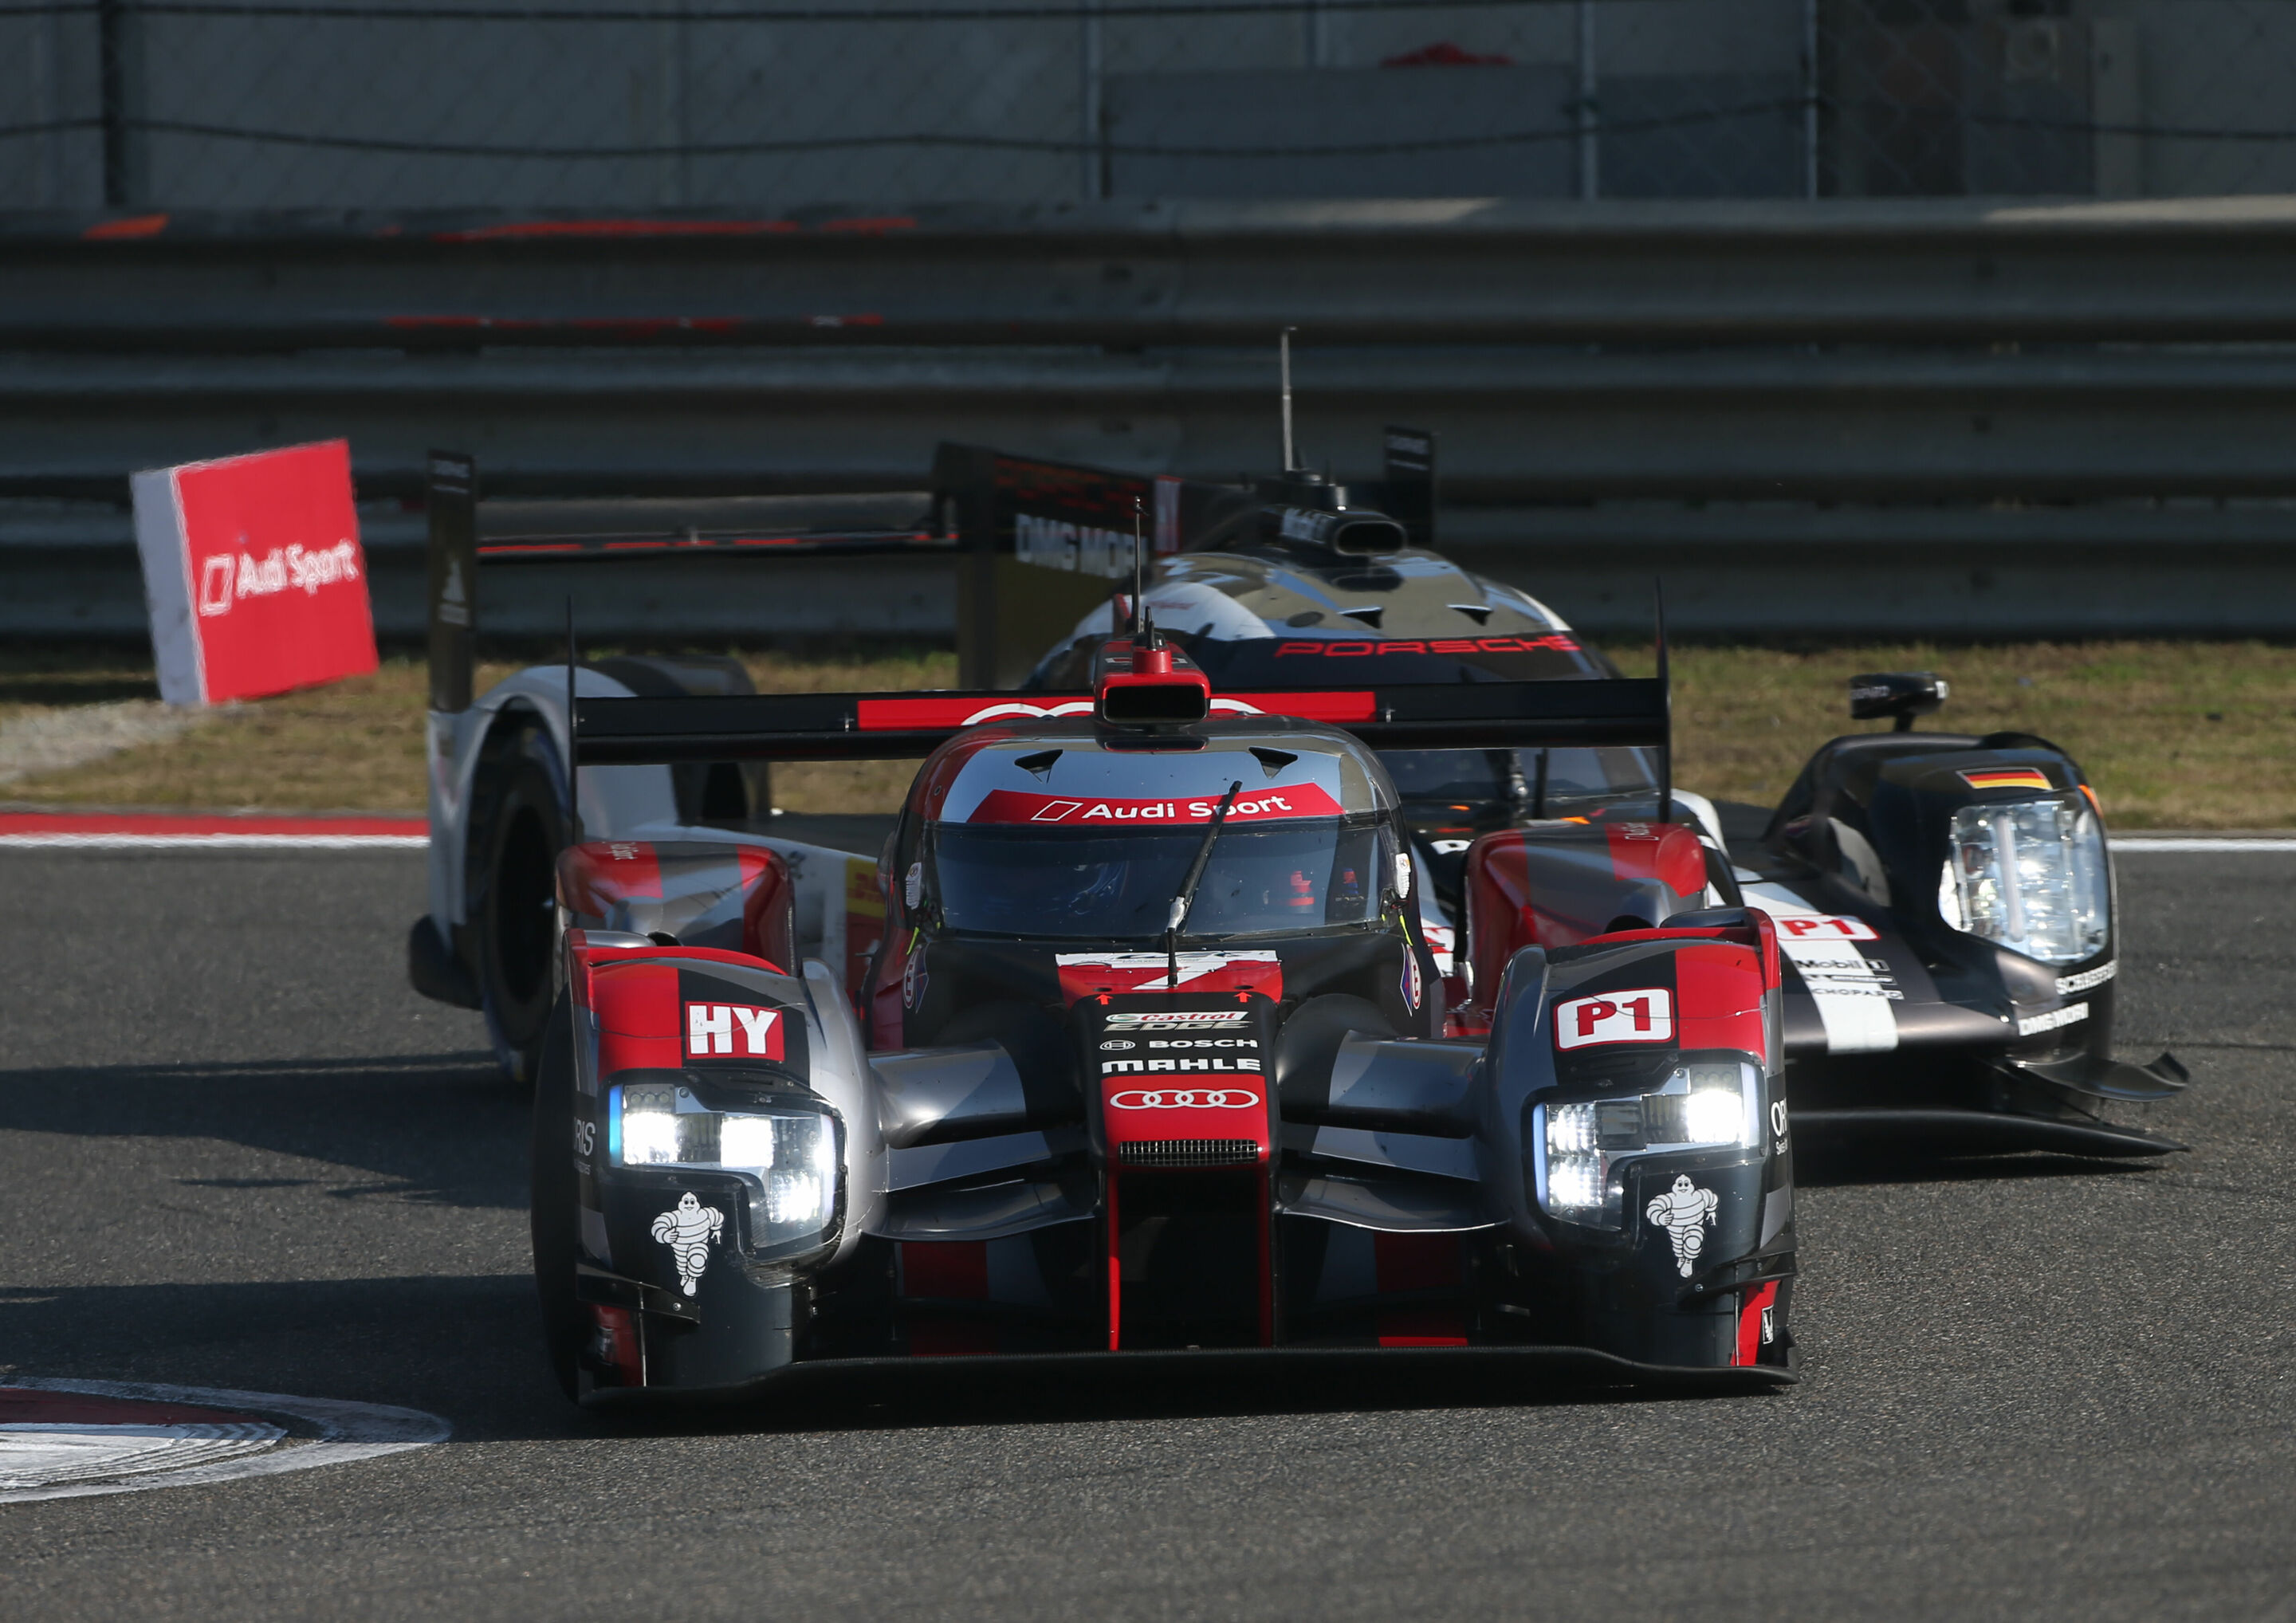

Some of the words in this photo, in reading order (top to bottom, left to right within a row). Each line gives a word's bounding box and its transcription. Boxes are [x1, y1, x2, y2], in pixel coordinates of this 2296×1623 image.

[1015, 513, 1075, 571] DMG
[237, 548, 287, 599] Audi
[285, 538, 359, 598] Sport
[1274, 635, 1581, 657] PORSCHE
[1082, 802, 1176, 819] Audi
[1779, 919, 1856, 936] P1
[1795, 960, 1863, 969] Mobil
[1813, 988, 1904, 998] CHOPARD
[1138, 1012, 1236, 1022] Castrol
[1577, 997, 1651, 1037] P1
[690, 1005, 778, 1055] HY
[1103, 1021, 1253, 1032] EDGE
[1149, 1039, 1258, 1048] BOSCH
[1102, 1058, 1261, 1074] MAHLE
[574, 1118, 596, 1156] RIS
